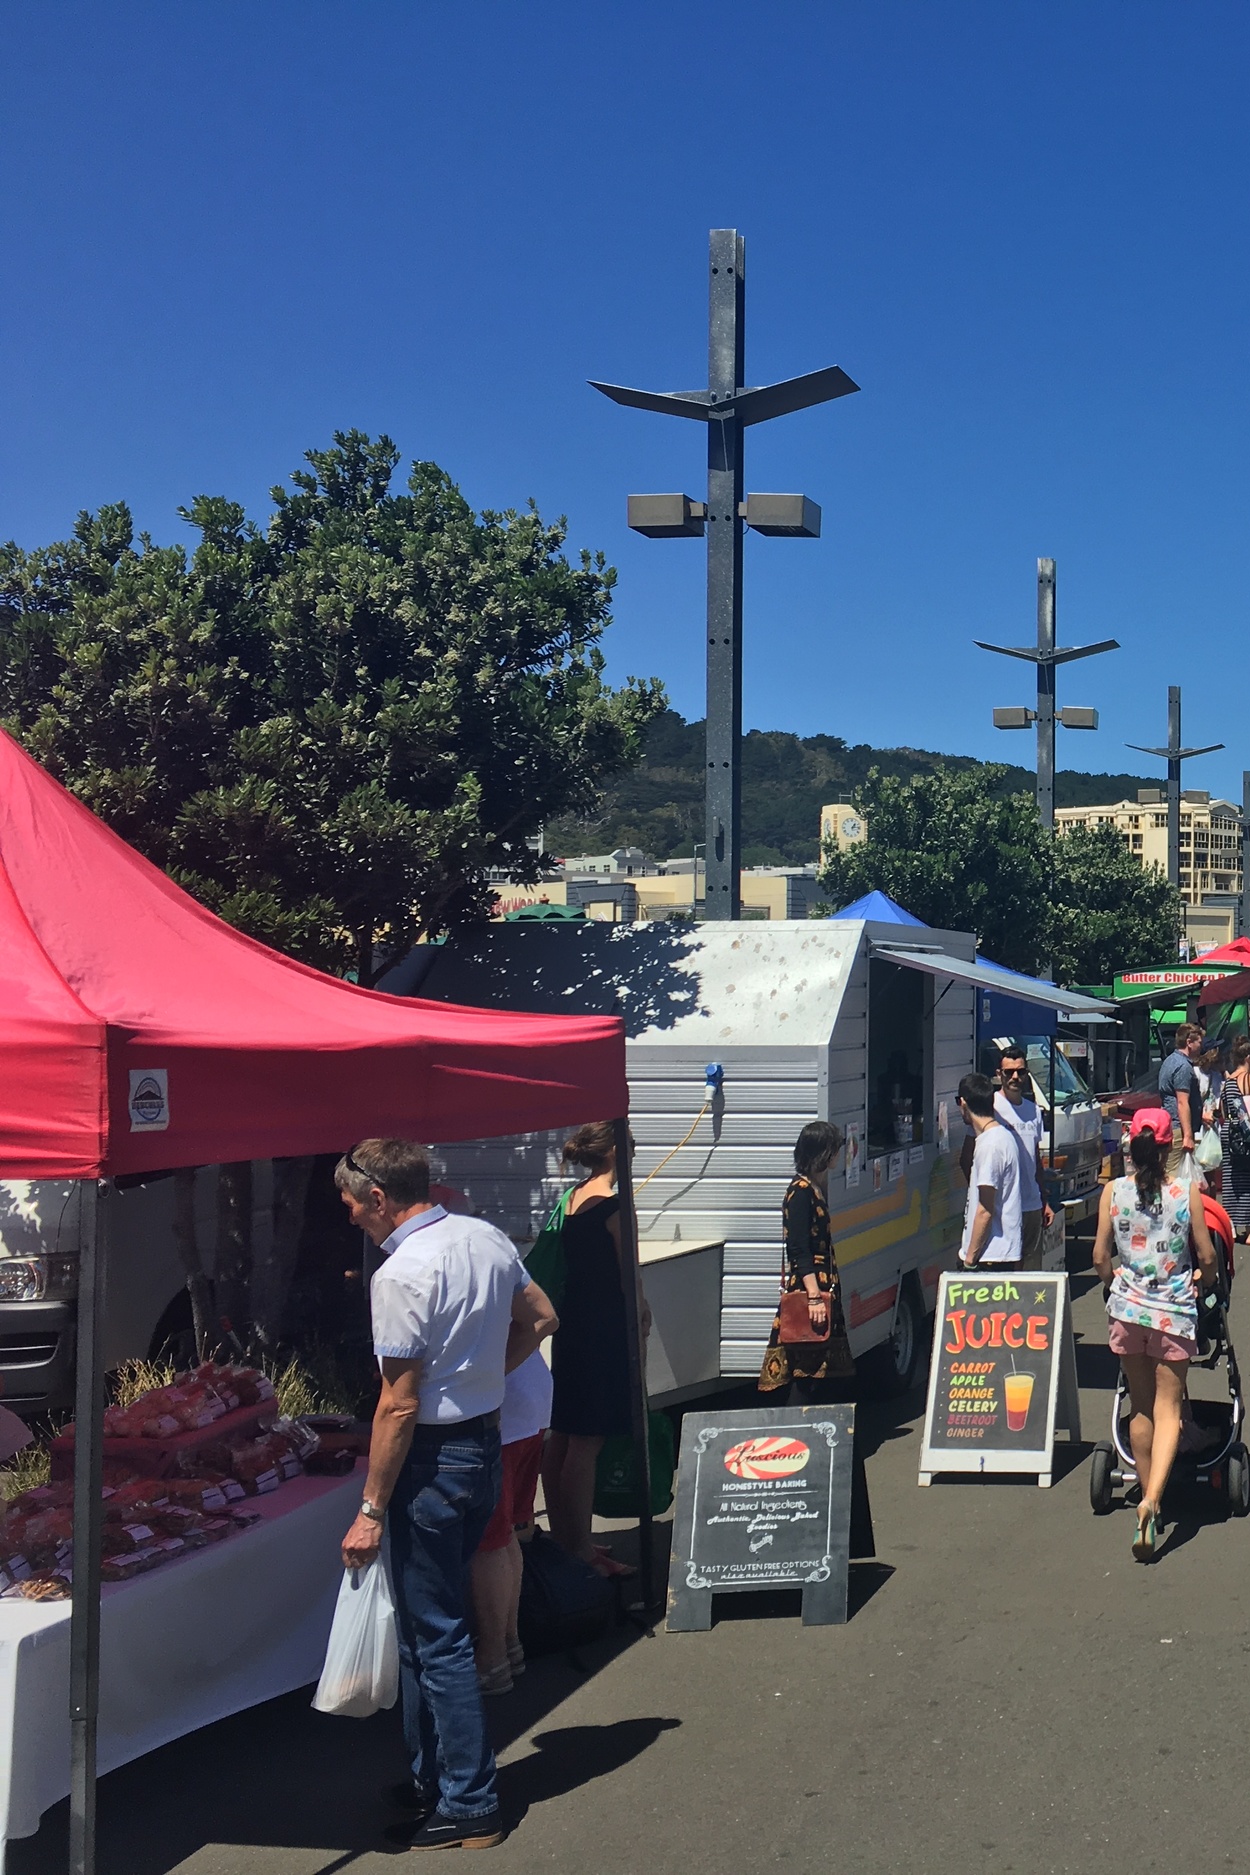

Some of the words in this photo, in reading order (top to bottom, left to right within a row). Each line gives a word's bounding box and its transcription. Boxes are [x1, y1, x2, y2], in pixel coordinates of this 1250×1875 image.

[1123, 973, 1162, 983] Butter
[948, 1281, 1020, 1307] Fresh
[945, 1310, 1049, 1354] JUICE
[950, 1362, 996, 1374] CARROT
[950, 1375, 986, 1386] APPLE
[949, 1388, 995, 1399] ORANGE
[948, 1400, 998, 1413] CELERY
[947, 1415, 998, 1425] BEETROOT
[946, 1428, 984, 1438] GINGER
[722, 1482, 773, 1491] HOMESTYLE
[775, 1480, 807, 1488] BAKING
[730, 1501, 758, 1511] Natural
[751, 1513, 790, 1524] Delicious
[790, 1511, 819, 1522] Baked
[700, 1565, 729, 1573] TASTY
[730, 1563, 764, 1572] GLUTEN
[764, 1562, 780, 1570] FREE
[782, 1560, 820, 1569] OPTIONS
